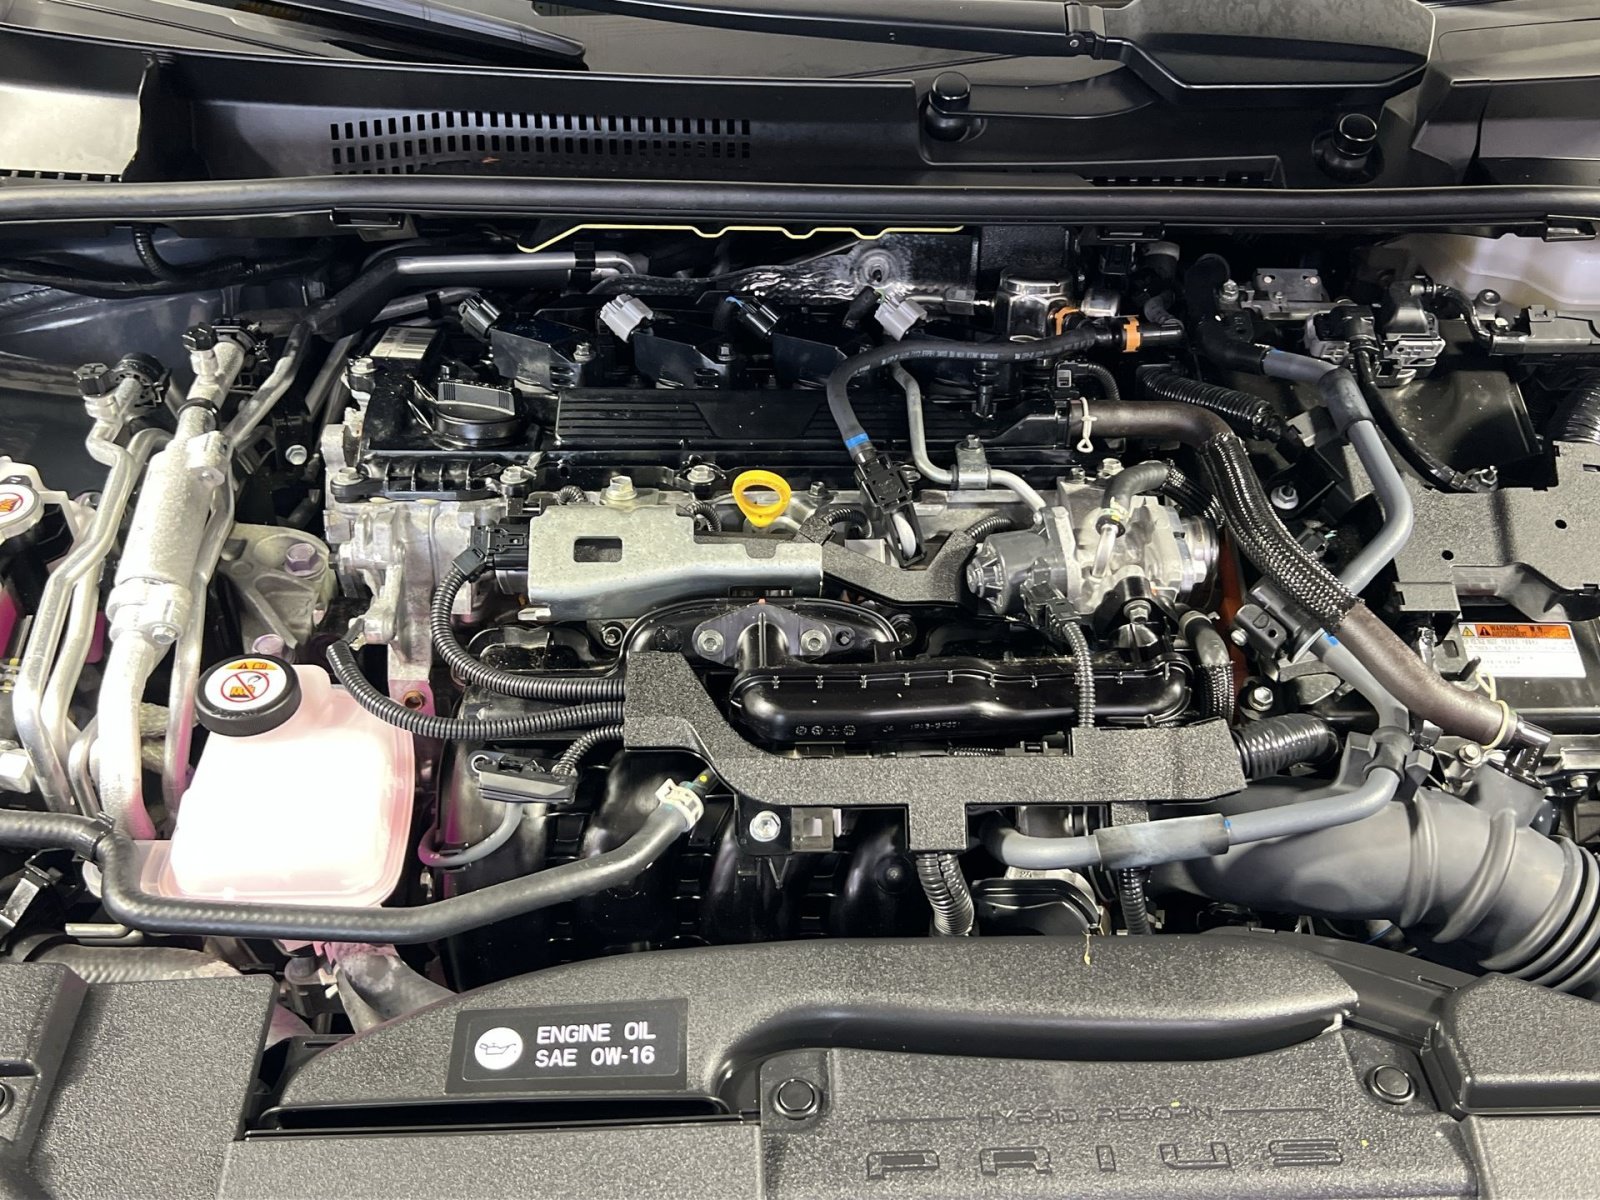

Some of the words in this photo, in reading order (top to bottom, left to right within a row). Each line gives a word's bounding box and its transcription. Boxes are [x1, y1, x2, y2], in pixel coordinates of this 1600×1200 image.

[536, 1024, 612, 1044] ENGINE
[624, 1021, 656, 1040] OIL
[535, 1049, 578, 1067] SAE
[590, 1046, 655, 1066] 0W-16
[976, 1108, 1080, 1125] HYBRID
[1096, 1106, 1213, 1122] REBORN
[866, 1139, 1343, 1180] PRIUS
